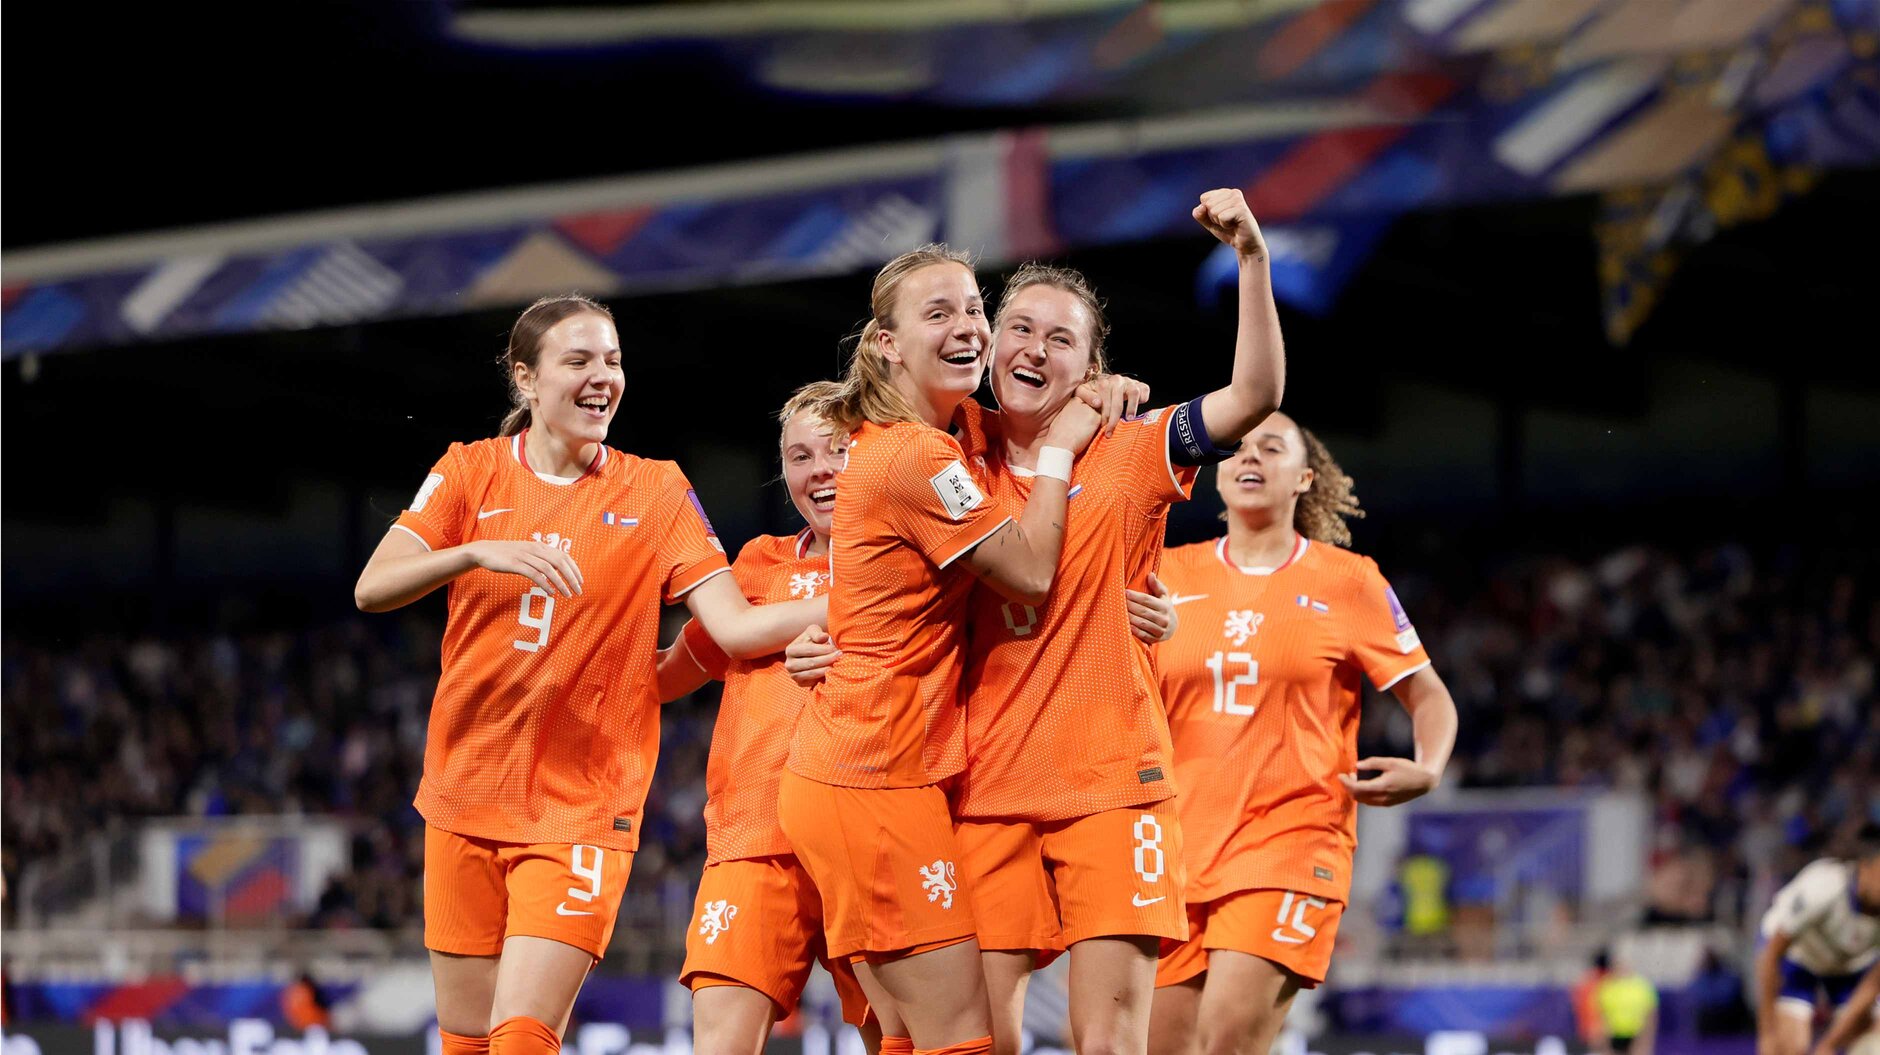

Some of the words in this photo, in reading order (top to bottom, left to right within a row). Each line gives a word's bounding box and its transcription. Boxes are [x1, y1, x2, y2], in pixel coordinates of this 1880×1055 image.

[1178, 404, 1193, 445] RESPEC
[513, 586, 555, 652] 9
[1206, 651, 1258, 715] 12
[568, 845, 604, 902] 9
[1134, 815, 1164, 882] 8
